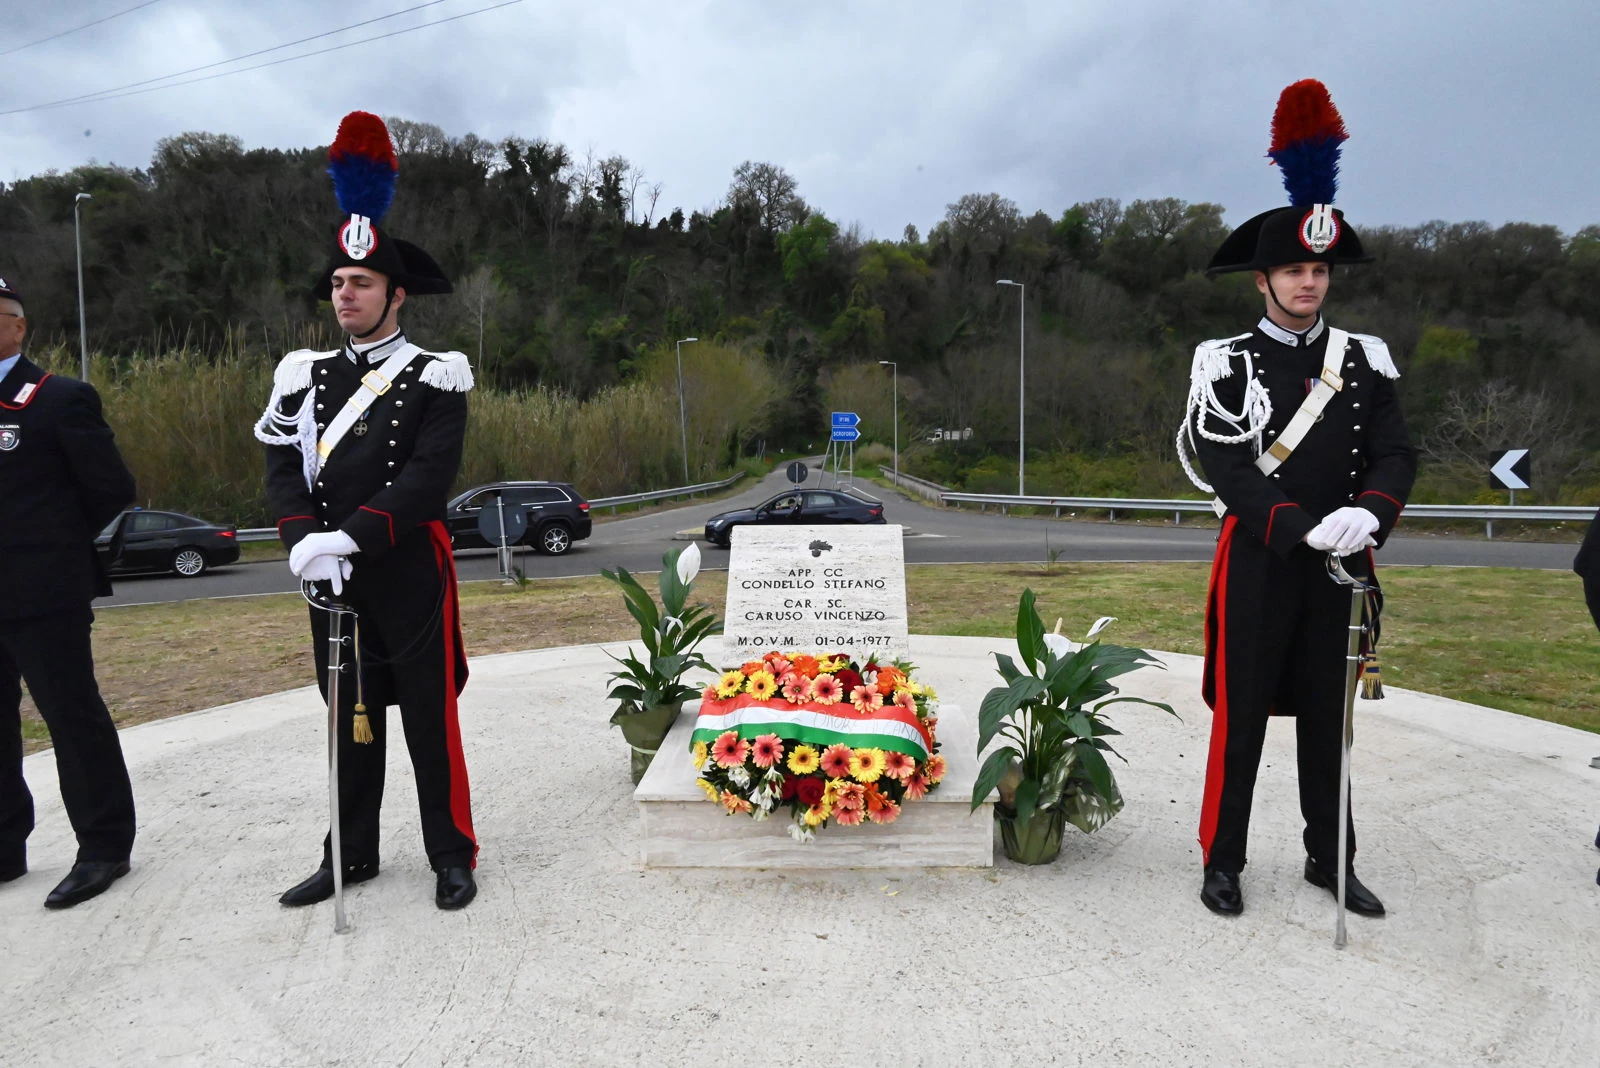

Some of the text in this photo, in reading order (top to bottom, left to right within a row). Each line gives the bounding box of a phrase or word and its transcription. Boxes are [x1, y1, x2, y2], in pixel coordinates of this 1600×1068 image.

[824, 568, 843, 577] CC
[741, 579, 885, 589] CONDELLO STEFANO
[784, 599, 846, 608] CAR. SC.
[745, 611, 886, 621] CARUSO VINCENZO
[815, 636, 891, 646] 01-04-1977
